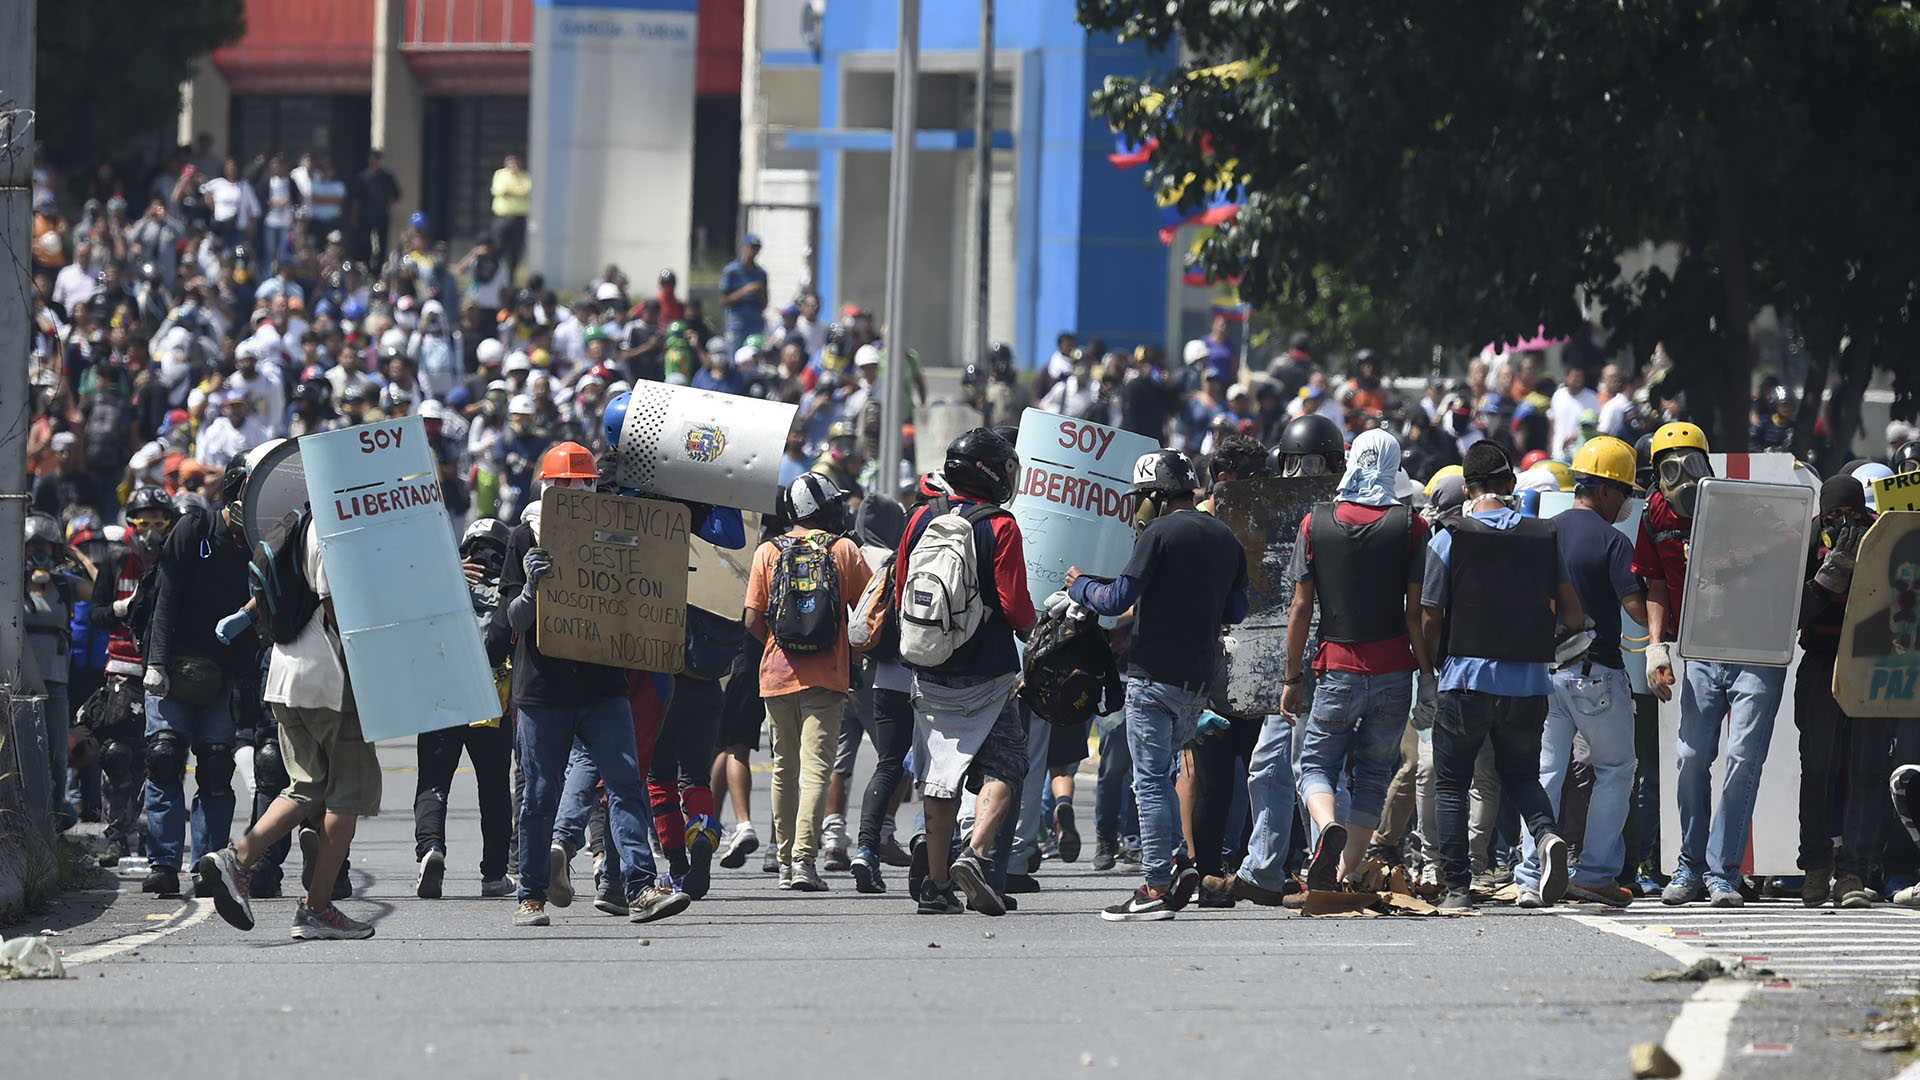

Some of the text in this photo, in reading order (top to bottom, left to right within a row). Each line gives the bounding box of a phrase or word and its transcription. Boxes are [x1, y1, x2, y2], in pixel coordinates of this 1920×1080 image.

[359, 427, 403, 454] SOY
[1058, 421, 1115, 460] SOY
[556, 493, 688, 545] RESISTENCIA
[577, 544, 643, 575] OESTE
[577, 568, 621, 594] DIOS
[626, 578, 663, 599] CON
[547, 590, 686, 628] NOSOTROS QUIEN
[544, 616, 686, 672] CONTRA NOSOTROS
[1869, 669, 1919, 701] PAZ
